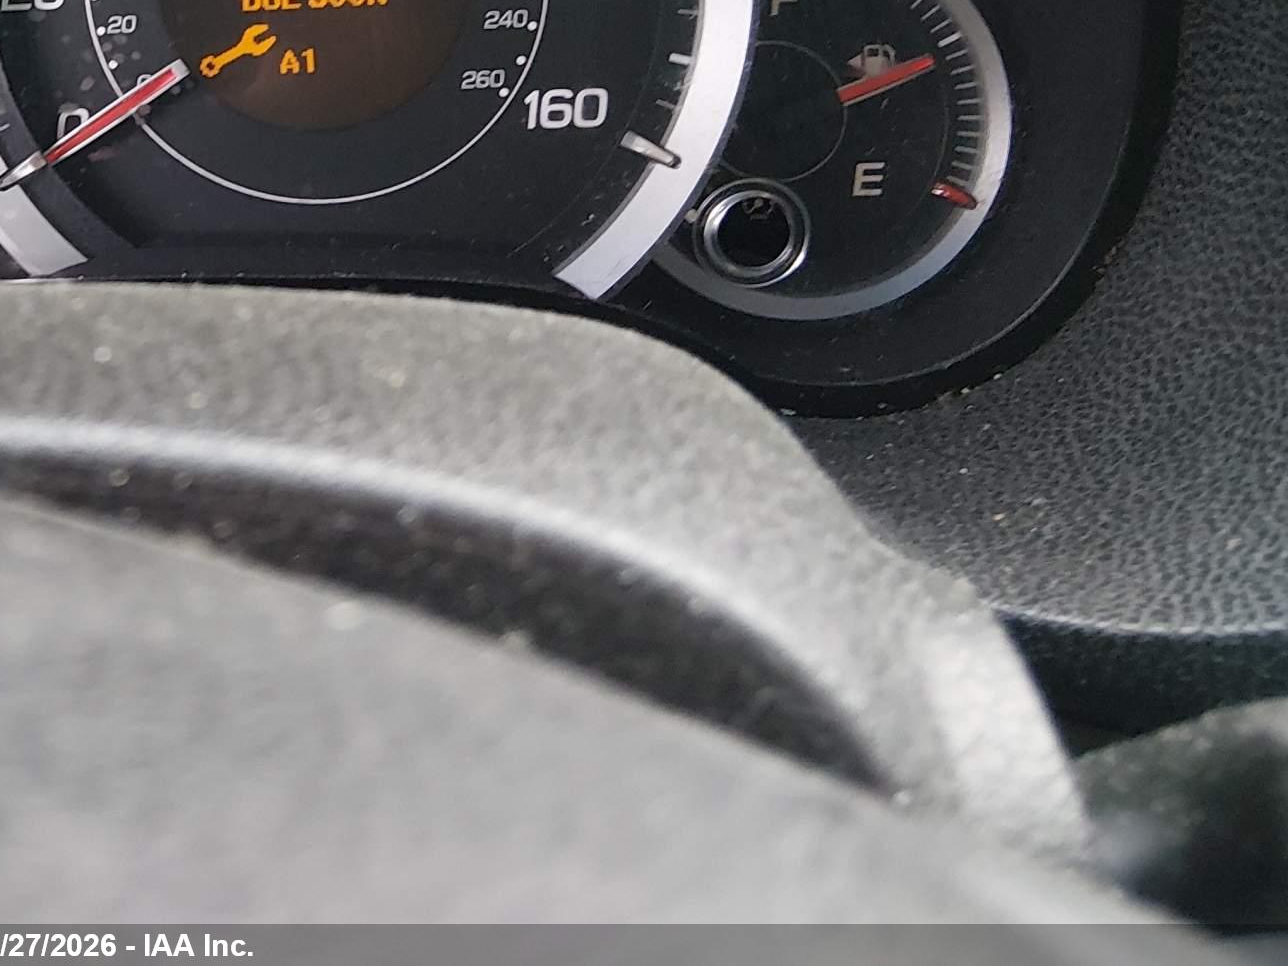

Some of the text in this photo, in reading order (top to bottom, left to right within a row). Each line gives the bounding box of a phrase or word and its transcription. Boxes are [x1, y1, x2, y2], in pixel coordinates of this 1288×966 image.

[106, 15, 137, 35] 20
[483, 9, 528, 30] 240
[279, 48, 315, 75] A1
[460, 70, 504, 90] 260
[523, 87, 609, 130] 160
[852, 161, 886, 196] E
